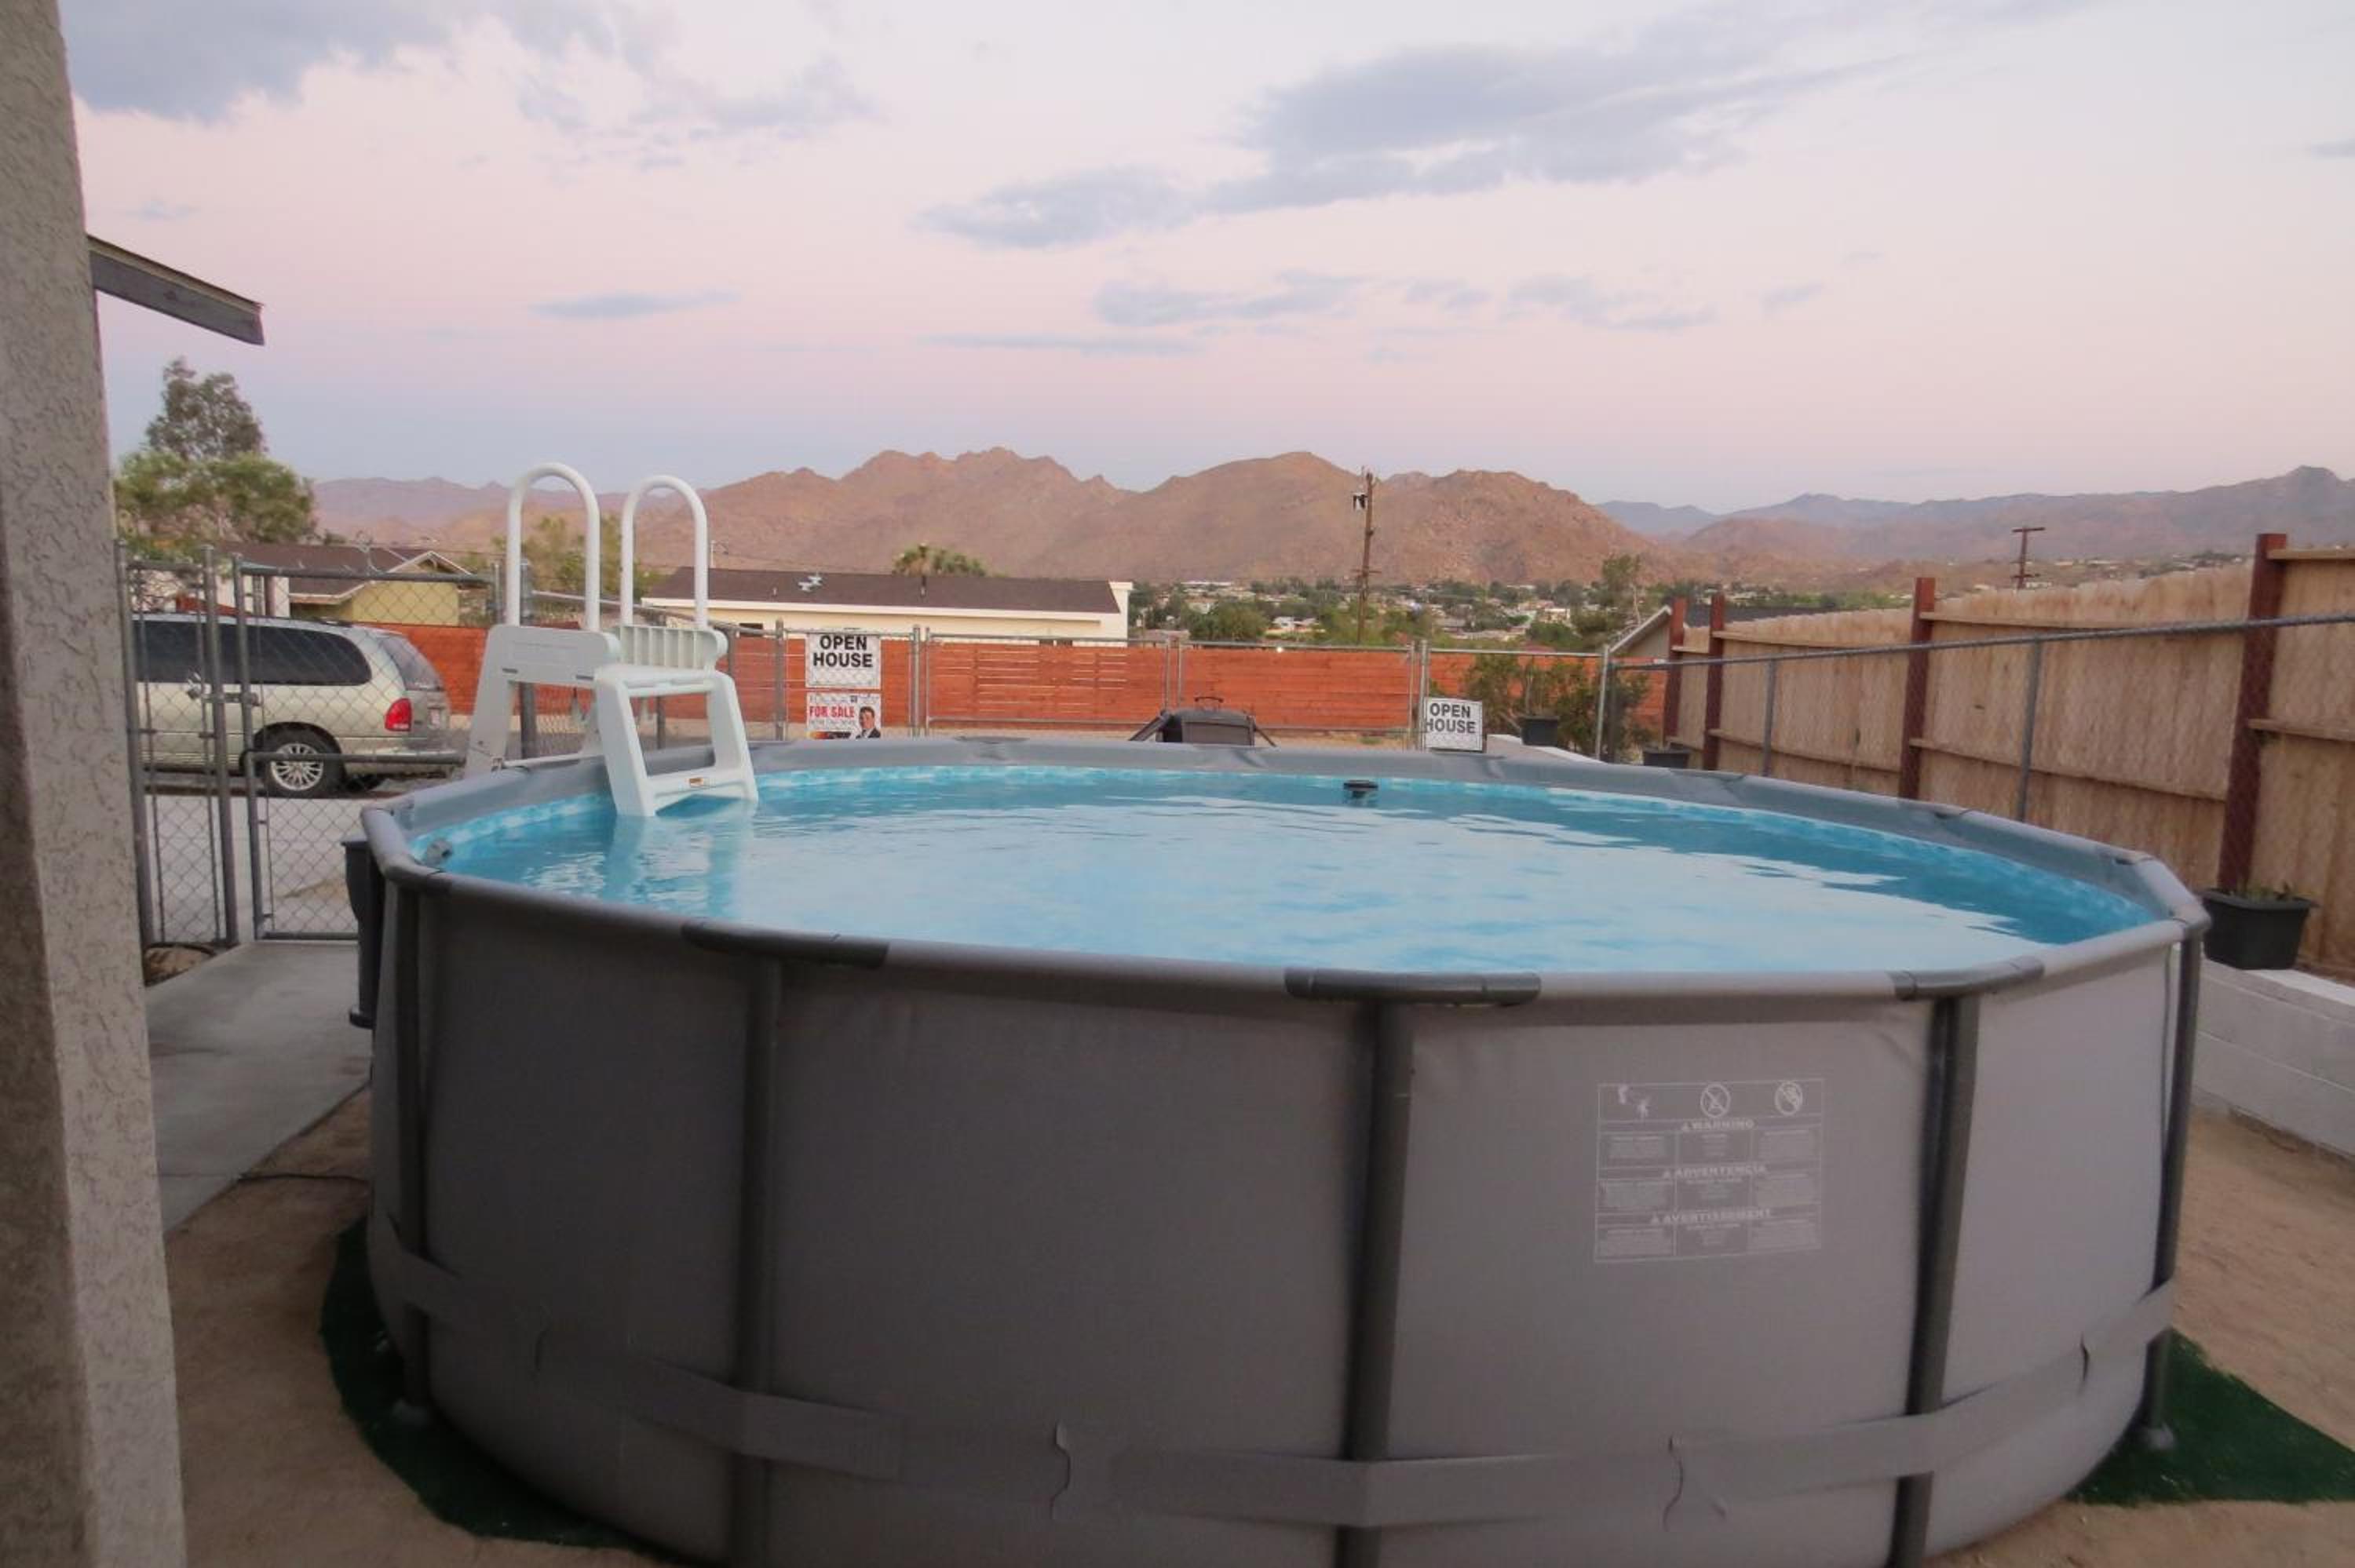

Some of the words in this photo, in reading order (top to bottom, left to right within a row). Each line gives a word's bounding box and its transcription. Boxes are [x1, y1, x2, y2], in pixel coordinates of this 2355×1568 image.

[820, 635, 867, 650] OPEN
[813, 653, 873, 667] HOUSE
[809, 706, 828, 717] FOR
[831, 706, 855, 717] SALE
[1429, 702, 1471, 718] OPEN
[1425, 718, 1476, 734] HOUSE
